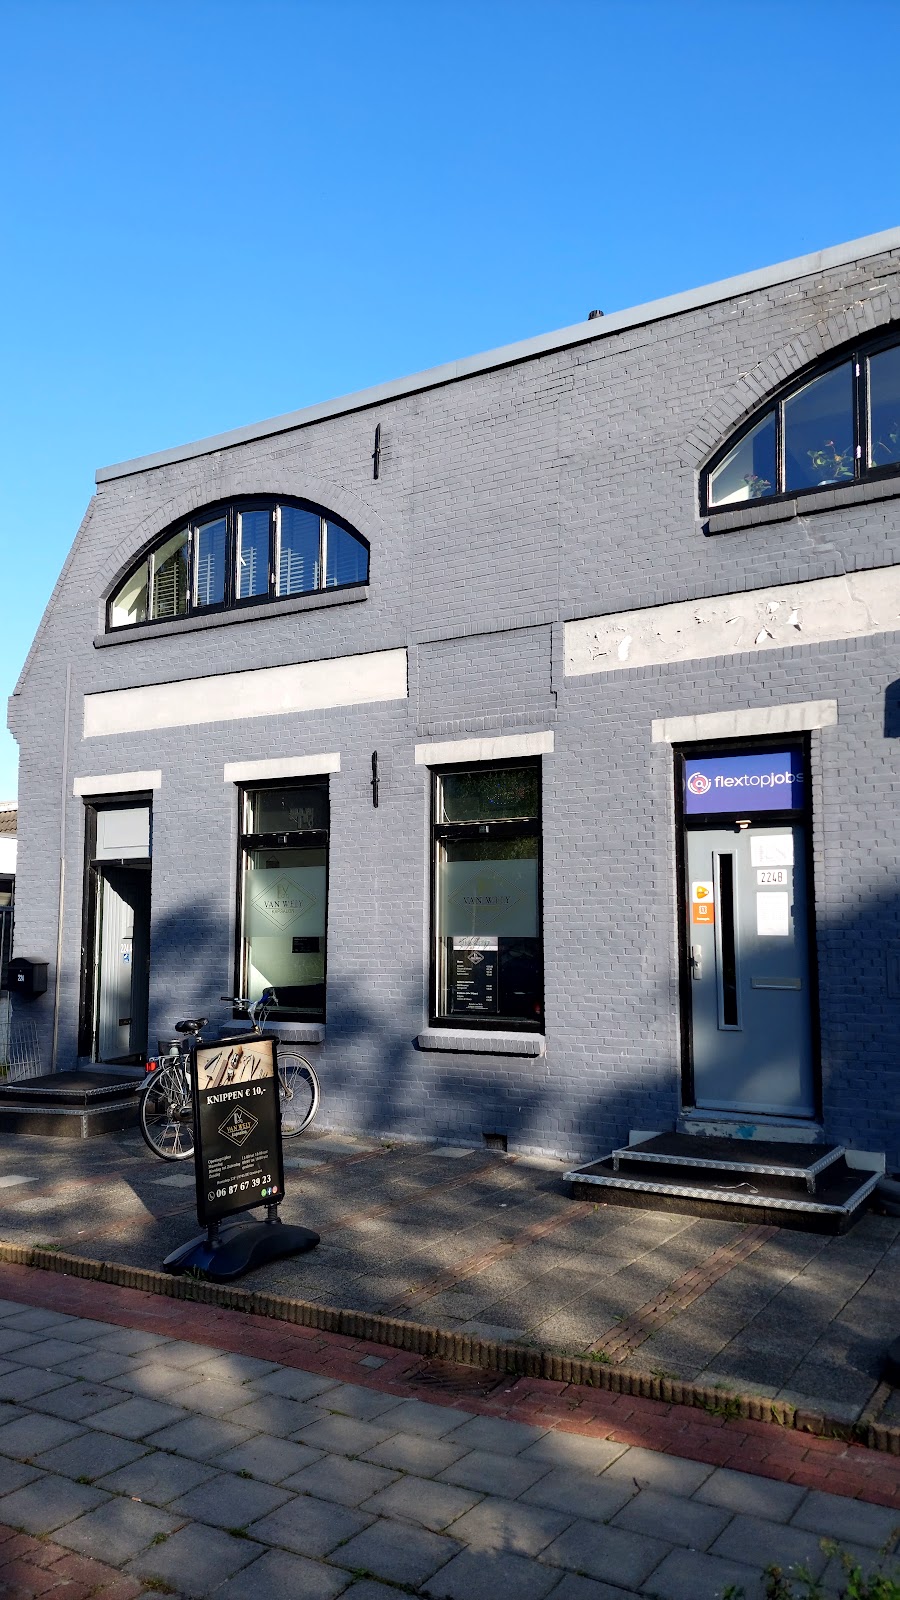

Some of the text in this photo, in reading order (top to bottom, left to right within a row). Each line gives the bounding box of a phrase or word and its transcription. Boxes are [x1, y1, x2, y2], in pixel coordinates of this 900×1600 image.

[714, 771, 804, 788] flextopjobs
[264, 900, 280, 908] VAN
[463, 896, 482, 904] VAN
[206, 1086, 266, 1105] KNIPPEN € 10,-
[226, 1124, 239, 1134] VAN
[216, 1187, 227, 1198] 06
[228, 1184, 238, 1195] 87
[240, 1180, 250, 1191] 67
[251, 1177, 261, 1188] 39
[261, 1174, 272, 1185] 23
